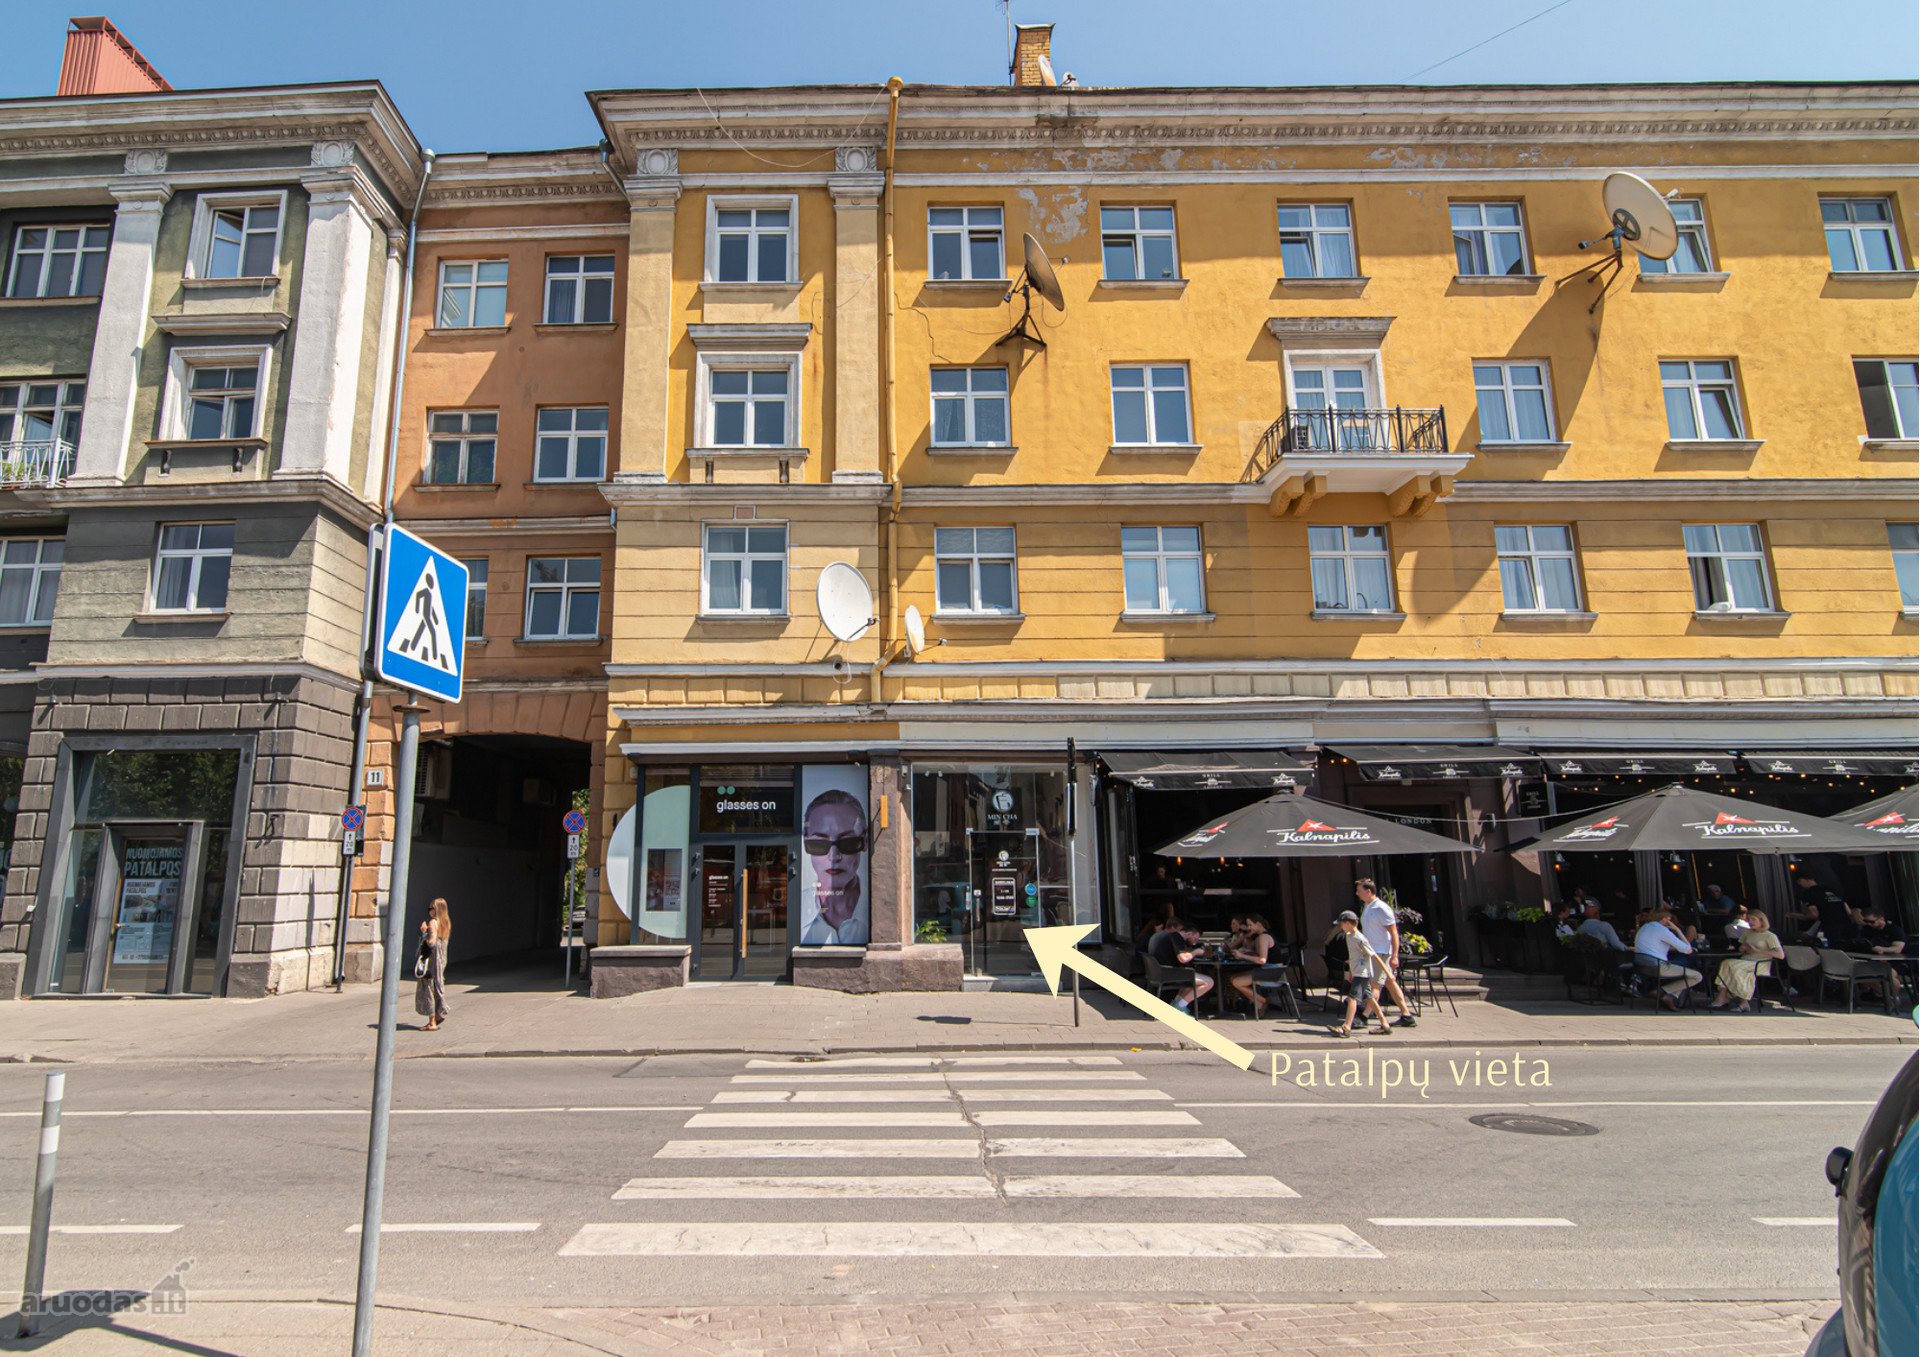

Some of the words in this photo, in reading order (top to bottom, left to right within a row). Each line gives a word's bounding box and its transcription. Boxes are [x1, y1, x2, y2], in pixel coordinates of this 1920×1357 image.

[370, 771, 380, 783] 11
[716, 799, 759, 813] glasses
[761, 801, 776, 810] on
[1695, 823, 1799, 836] Kalnapilis
[1277, 830, 1371, 843] Kalnapilis
